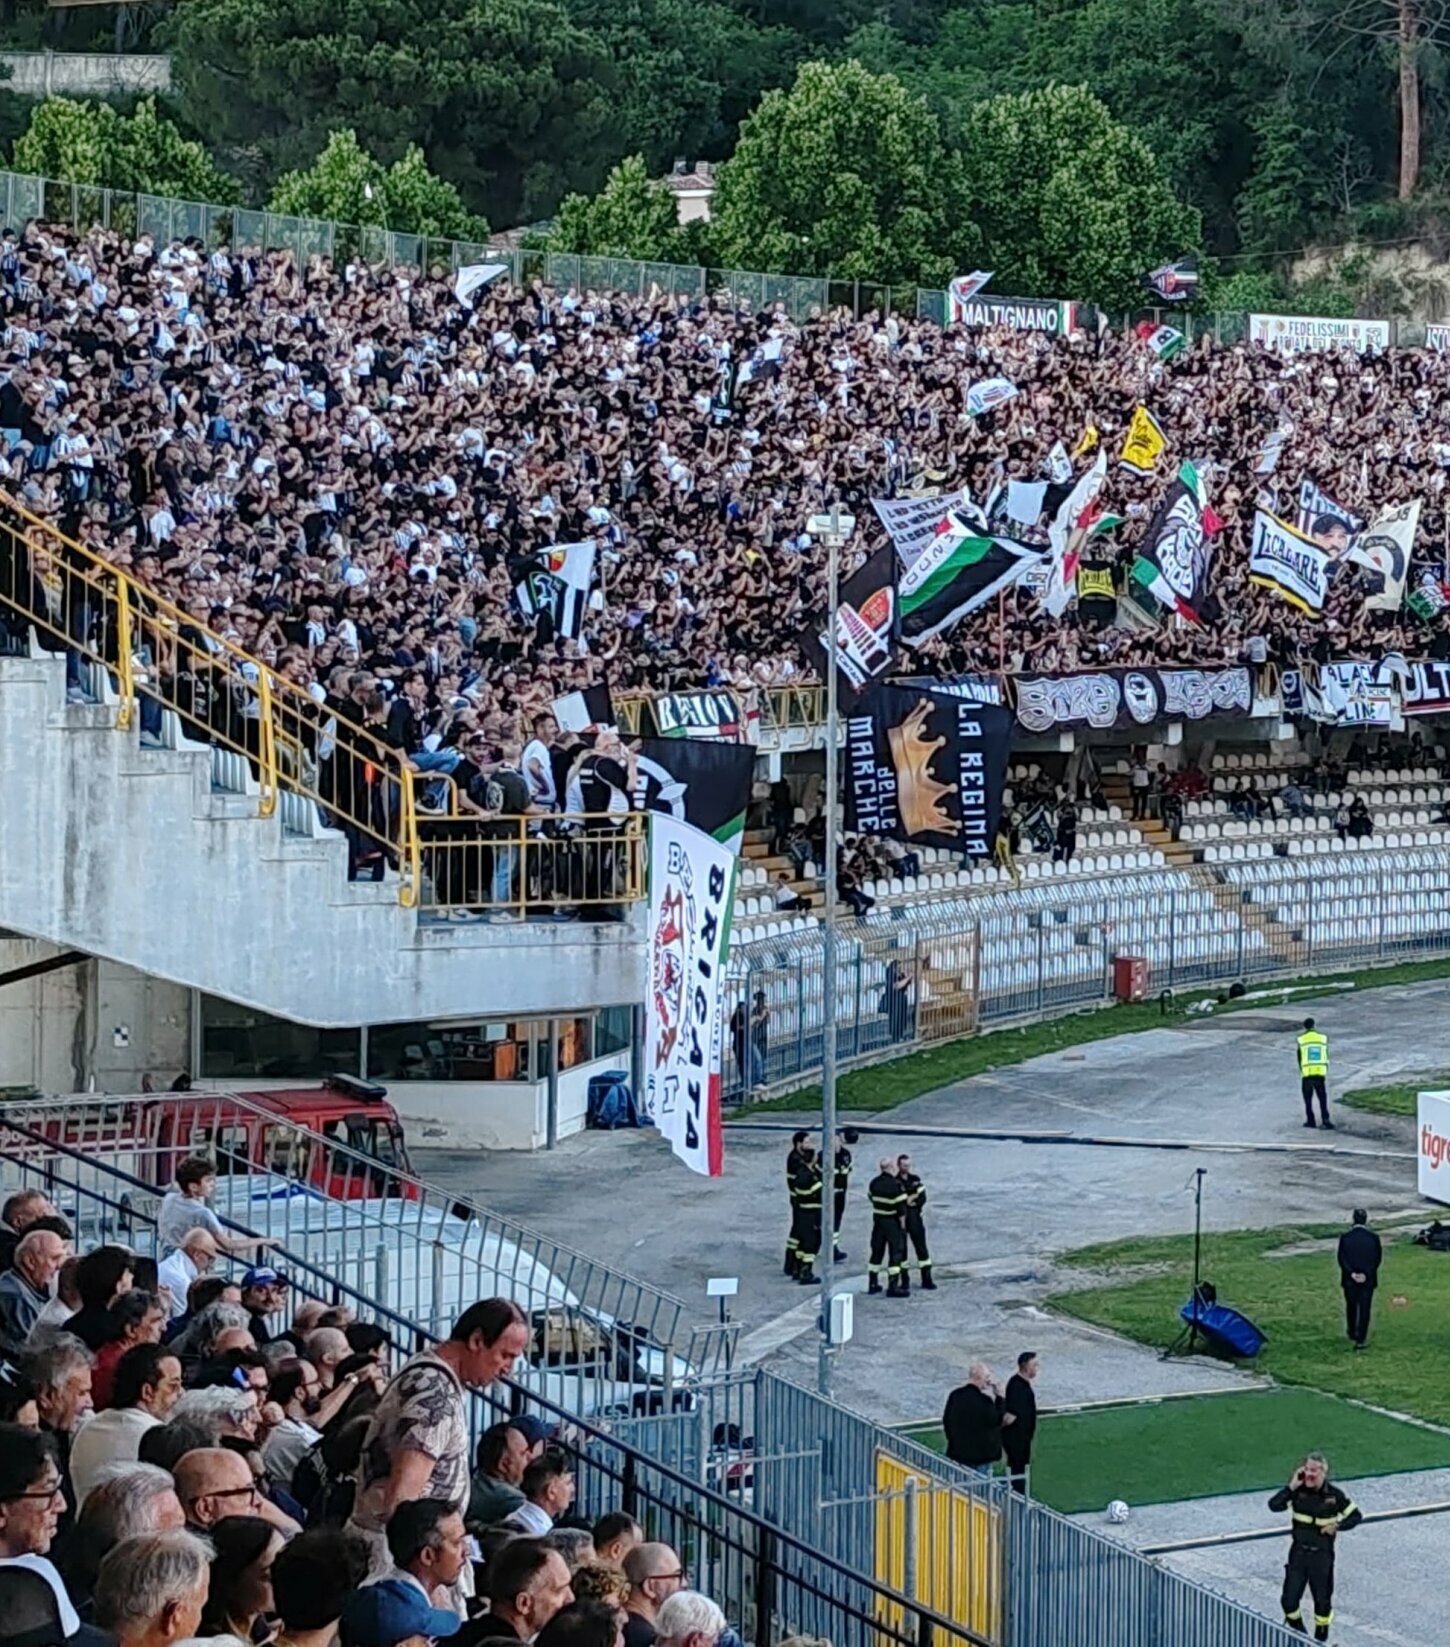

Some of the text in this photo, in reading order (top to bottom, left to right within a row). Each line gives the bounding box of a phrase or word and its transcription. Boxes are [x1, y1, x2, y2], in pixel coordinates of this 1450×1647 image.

[962, 303, 1058, 331] MALTIGNANO
[1288, 321, 1350, 338] FEDELISSIMI
[848, 715, 880, 832] MARCHE
[957, 703, 990, 854] LA REGINA
